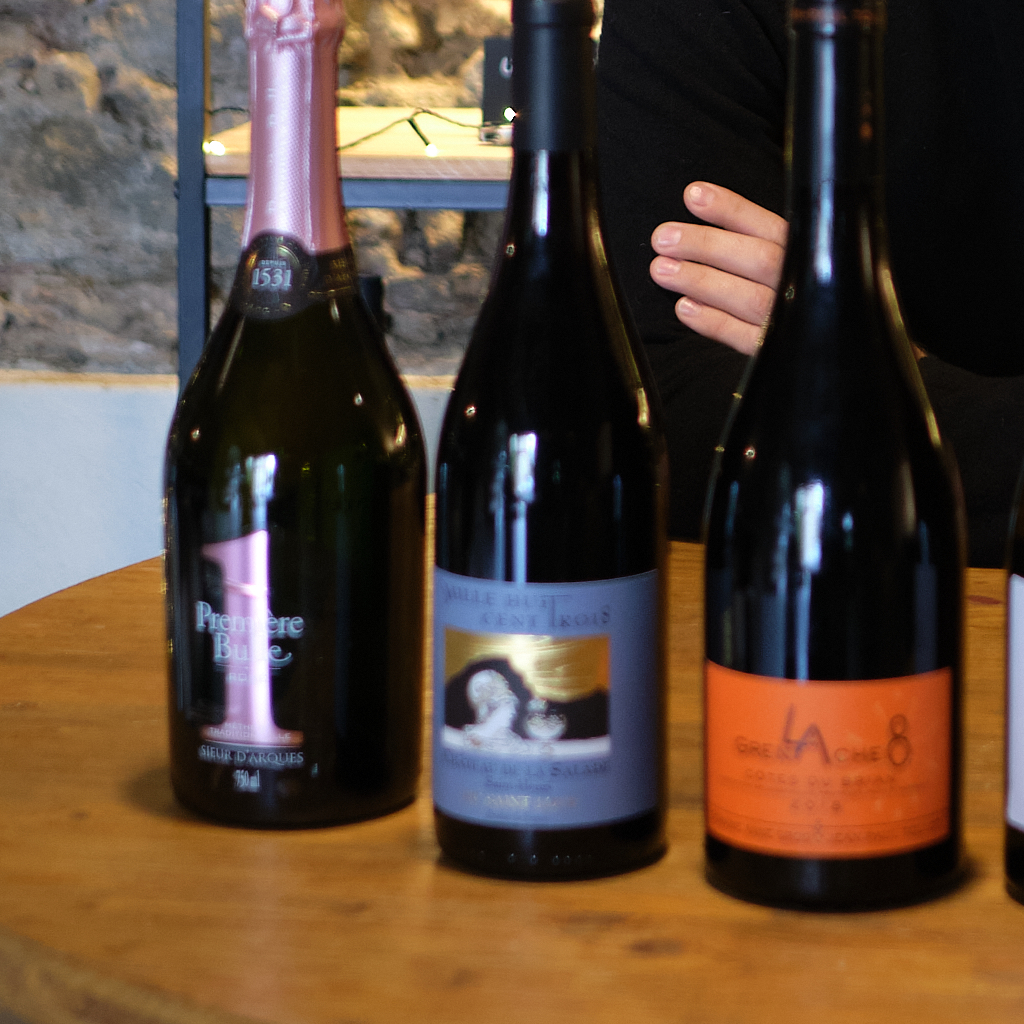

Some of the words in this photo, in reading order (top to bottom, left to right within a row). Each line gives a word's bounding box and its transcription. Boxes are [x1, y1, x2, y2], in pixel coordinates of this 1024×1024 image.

[252, 267, 292, 290] 1531
[196, 601, 304, 636] Premère
[214, 632, 292, 666] Bue
[201, 745, 233, 762] SIEUR
[237, 749, 304, 766] D'ARQUES
